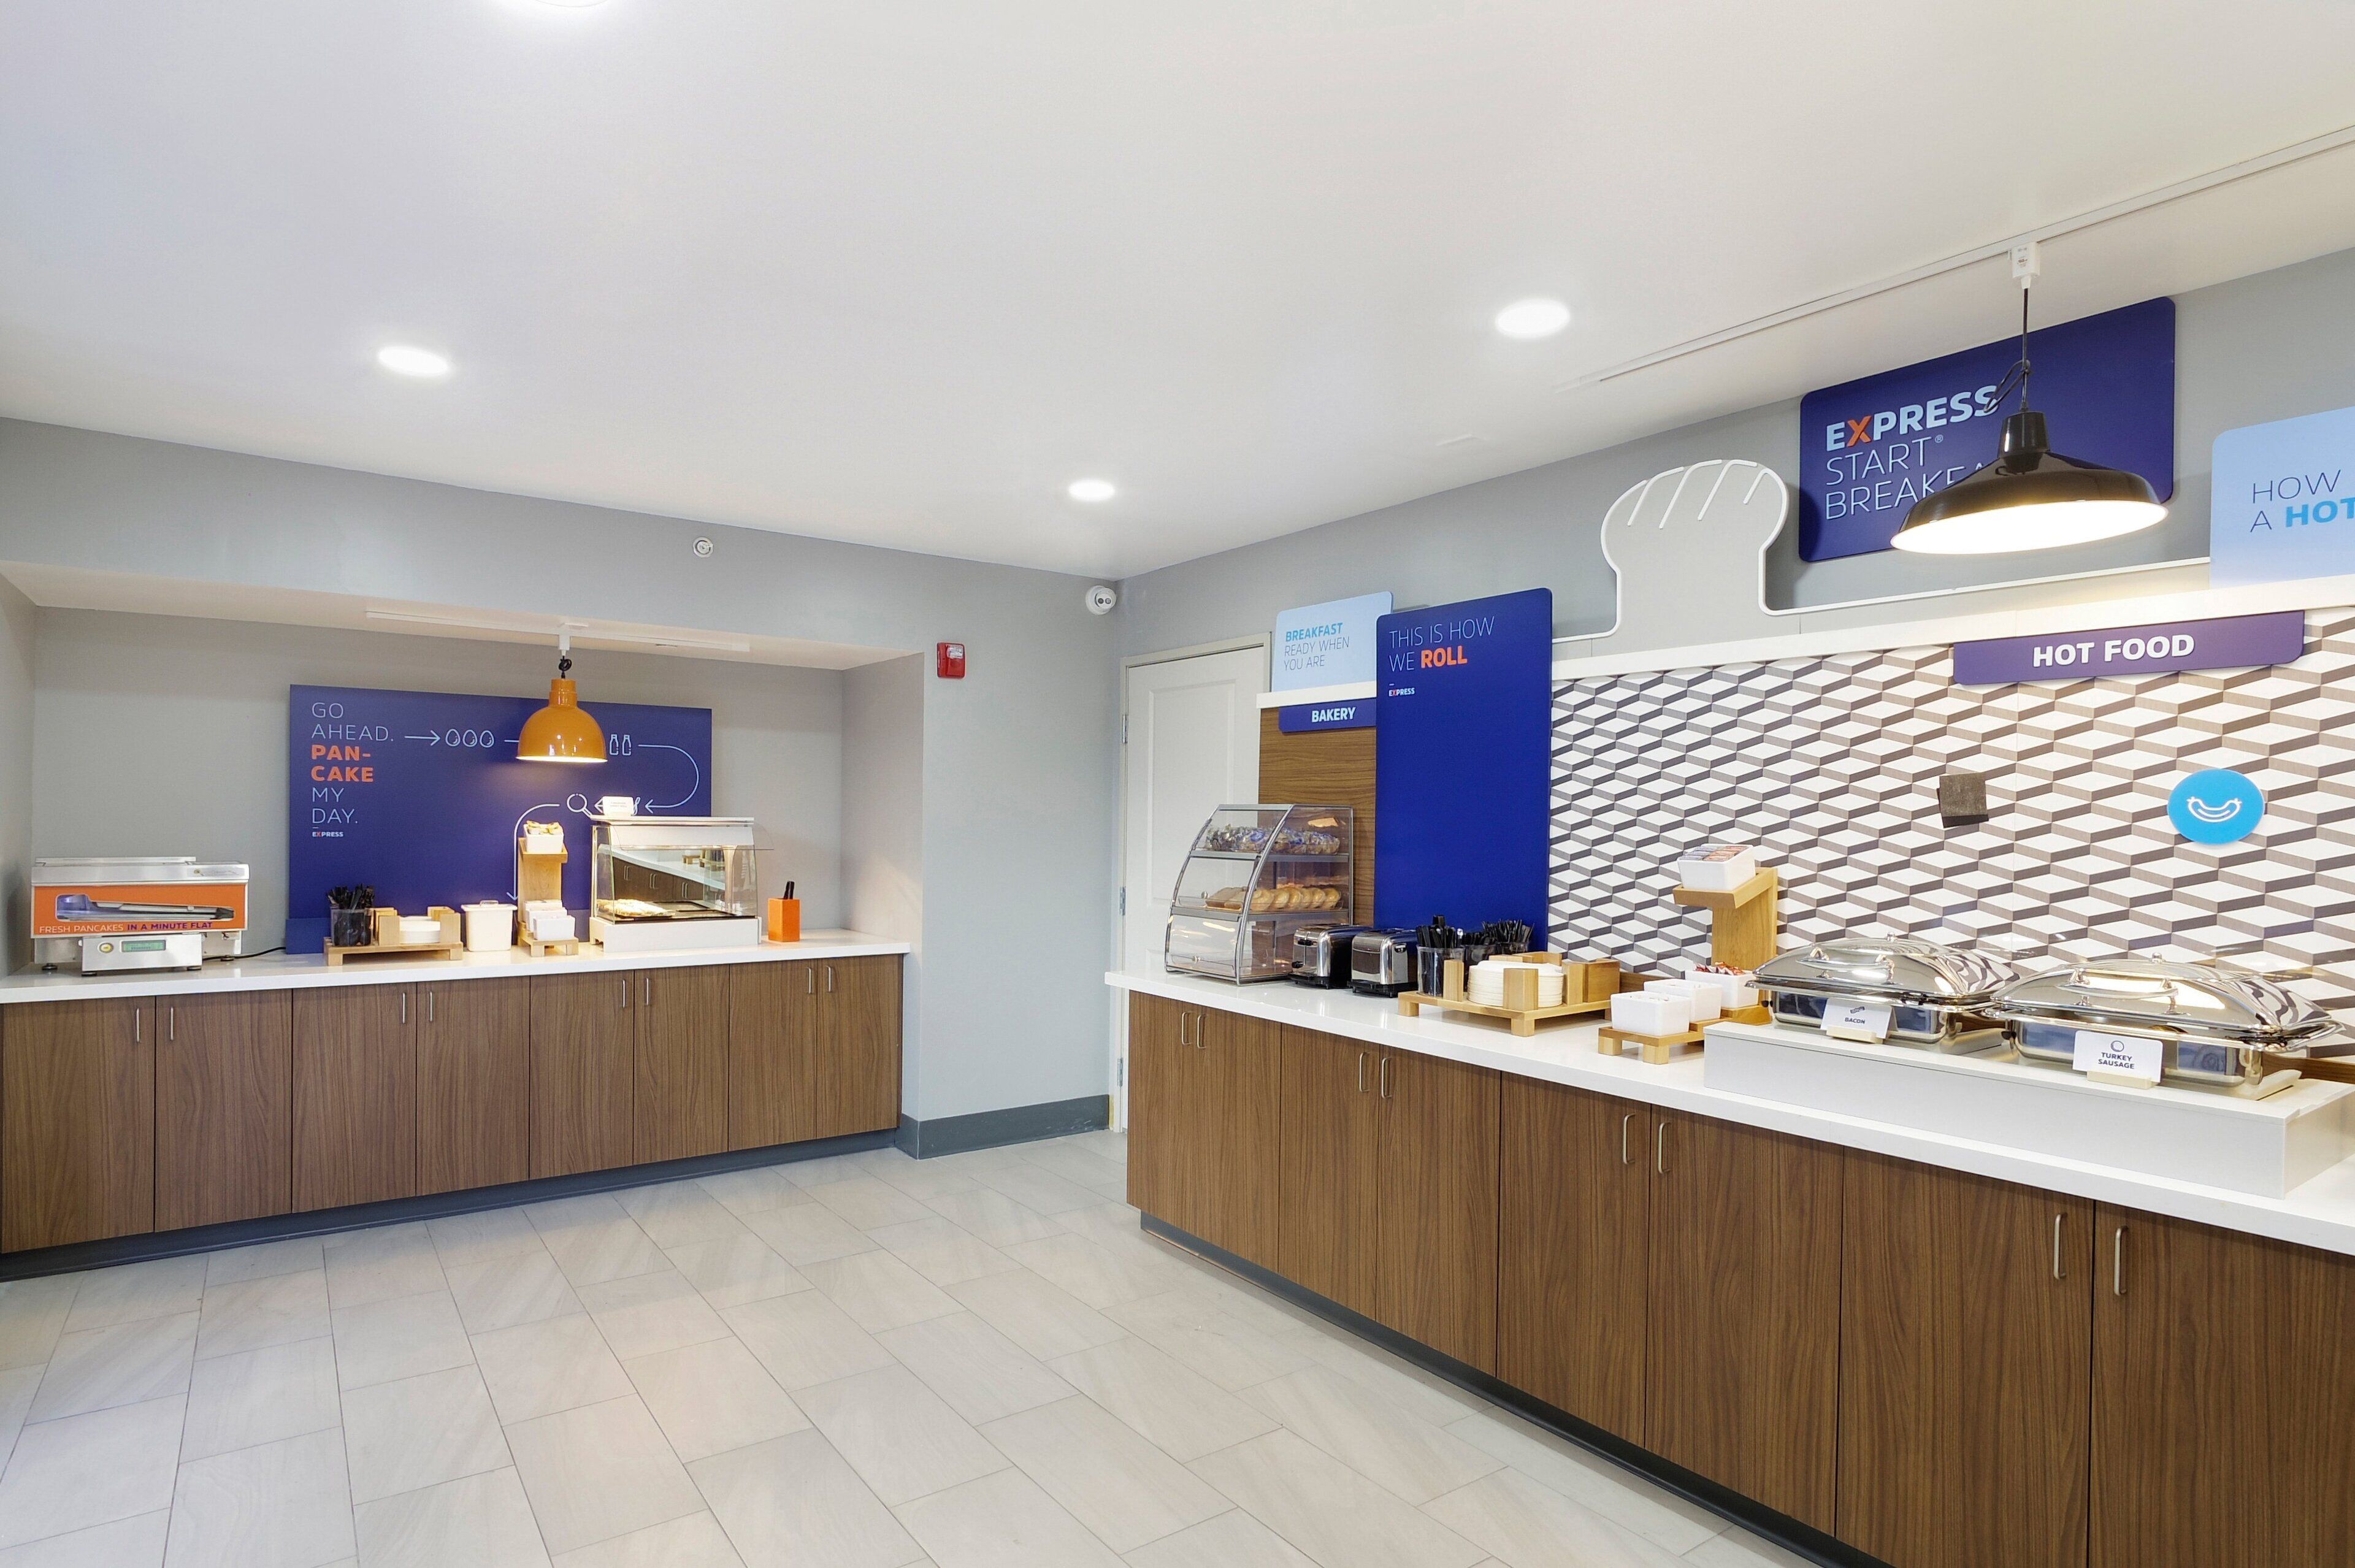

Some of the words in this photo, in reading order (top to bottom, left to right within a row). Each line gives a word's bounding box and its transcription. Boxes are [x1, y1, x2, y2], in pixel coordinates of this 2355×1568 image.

[1826, 385, 1999, 451] EXPRESS
[1826, 462, 1983, 520] BREAKF
[2253, 469, 2341, 504] HOW
[2250, 510, 2272, 533] A
[2285, 497, 2355, 528] HOT
[1285, 622, 1343, 642] BREAKFAST
[1389, 626, 1423, 649] THIS
[1430, 624, 1443, 644] IS
[1450, 616, 1495, 640] HOW
[1285, 642, 1315, 657] READY
[1319, 636, 1349, 652] WHEN
[2033, 641, 2095, 668] HOT
[2104, 634, 2195, 662] FOOD
[1284, 658, 1303, 671] YOU
[1306, 654, 1325, 668] ARE
[1389, 652, 1415, 672] WE
[1421, 645, 1468, 669] ROLL
[1388, 687, 1415, 697] EXPRESS
[312, 702, 344, 719] GO
[1311, 706, 1357, 723] BAKERY
[312, 724, 394, 741] AHEAD.
[312, 744, 371, 761] PAN-
[311, 765, 374, 782] CAKE
[312, 787, 344, 802] MY
[312, 808, 358, 824] DAY.
[39, 925, 71, 933] FRESH
[74, 924, 124, 933] PANCAKES
[2098, 1059, 2135, 1069] SAUSAGE
[2101, 1052, 2132, 1061] TURKEY
